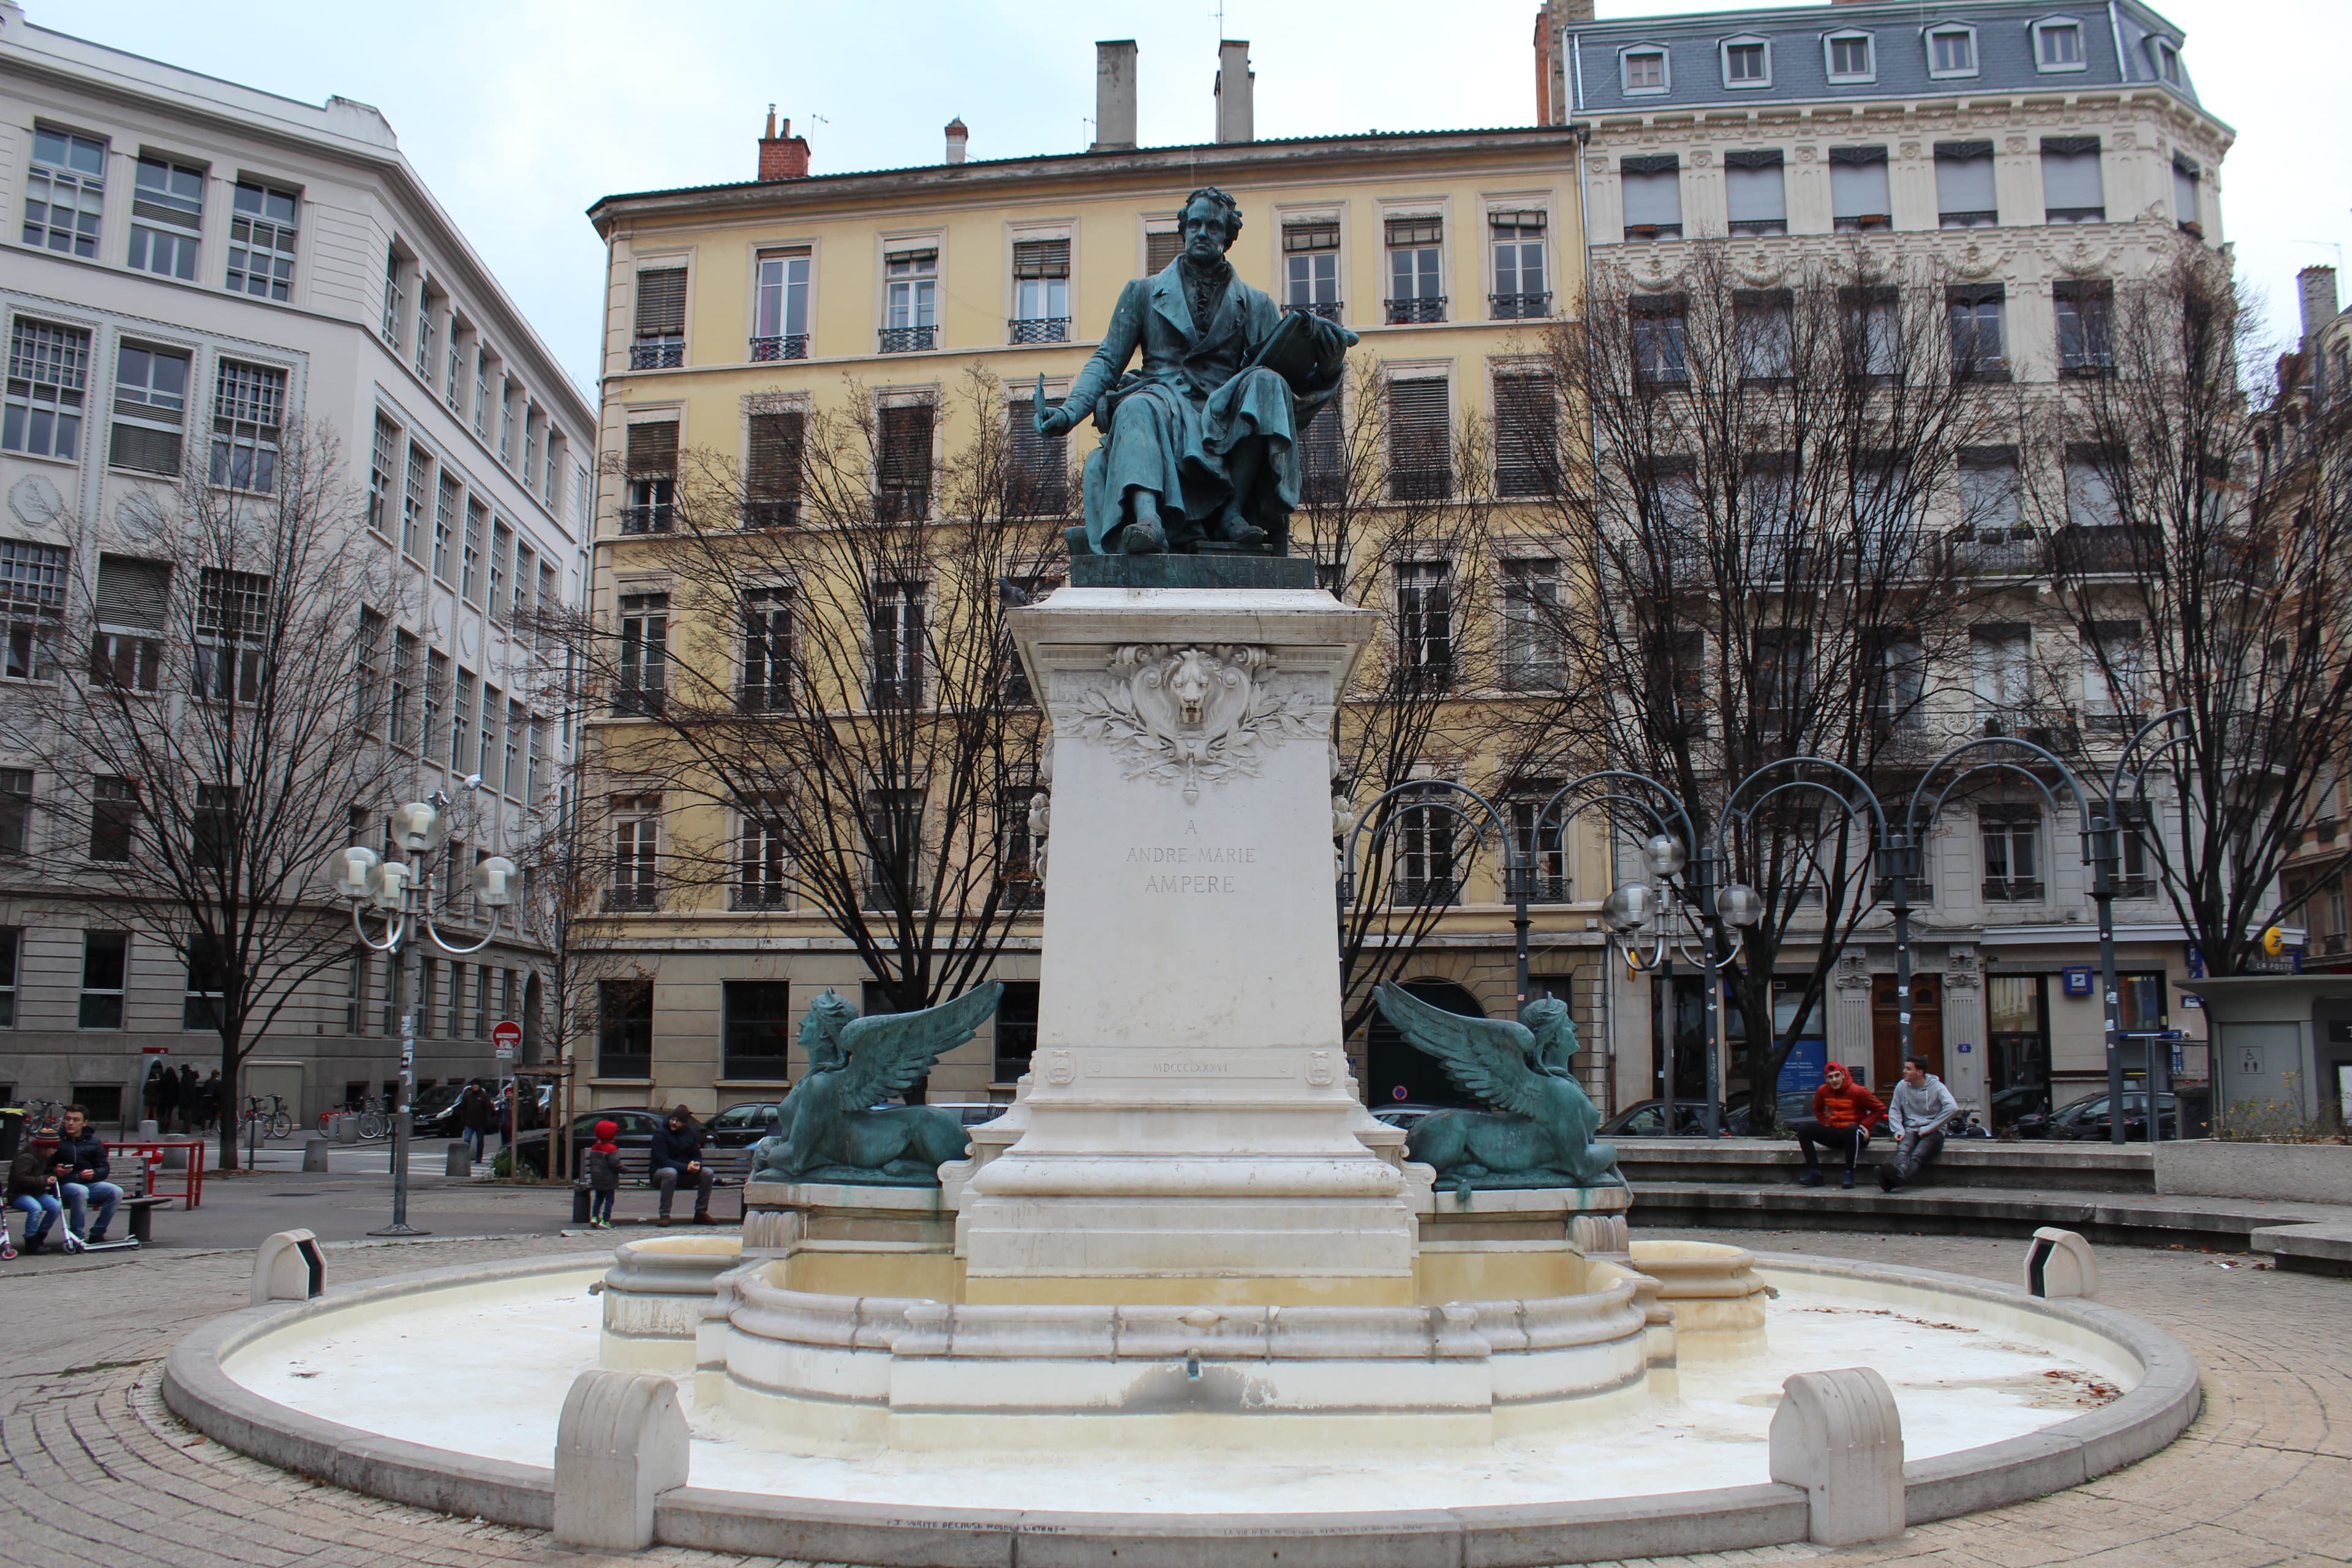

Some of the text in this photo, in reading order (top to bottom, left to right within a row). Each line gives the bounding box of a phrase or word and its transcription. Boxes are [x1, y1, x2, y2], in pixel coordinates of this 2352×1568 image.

[1183, 820, 1198, 834] A
[1145, 876, 1235, 893] AMPERE
[2269, 962, 2293, 971] POSTE
